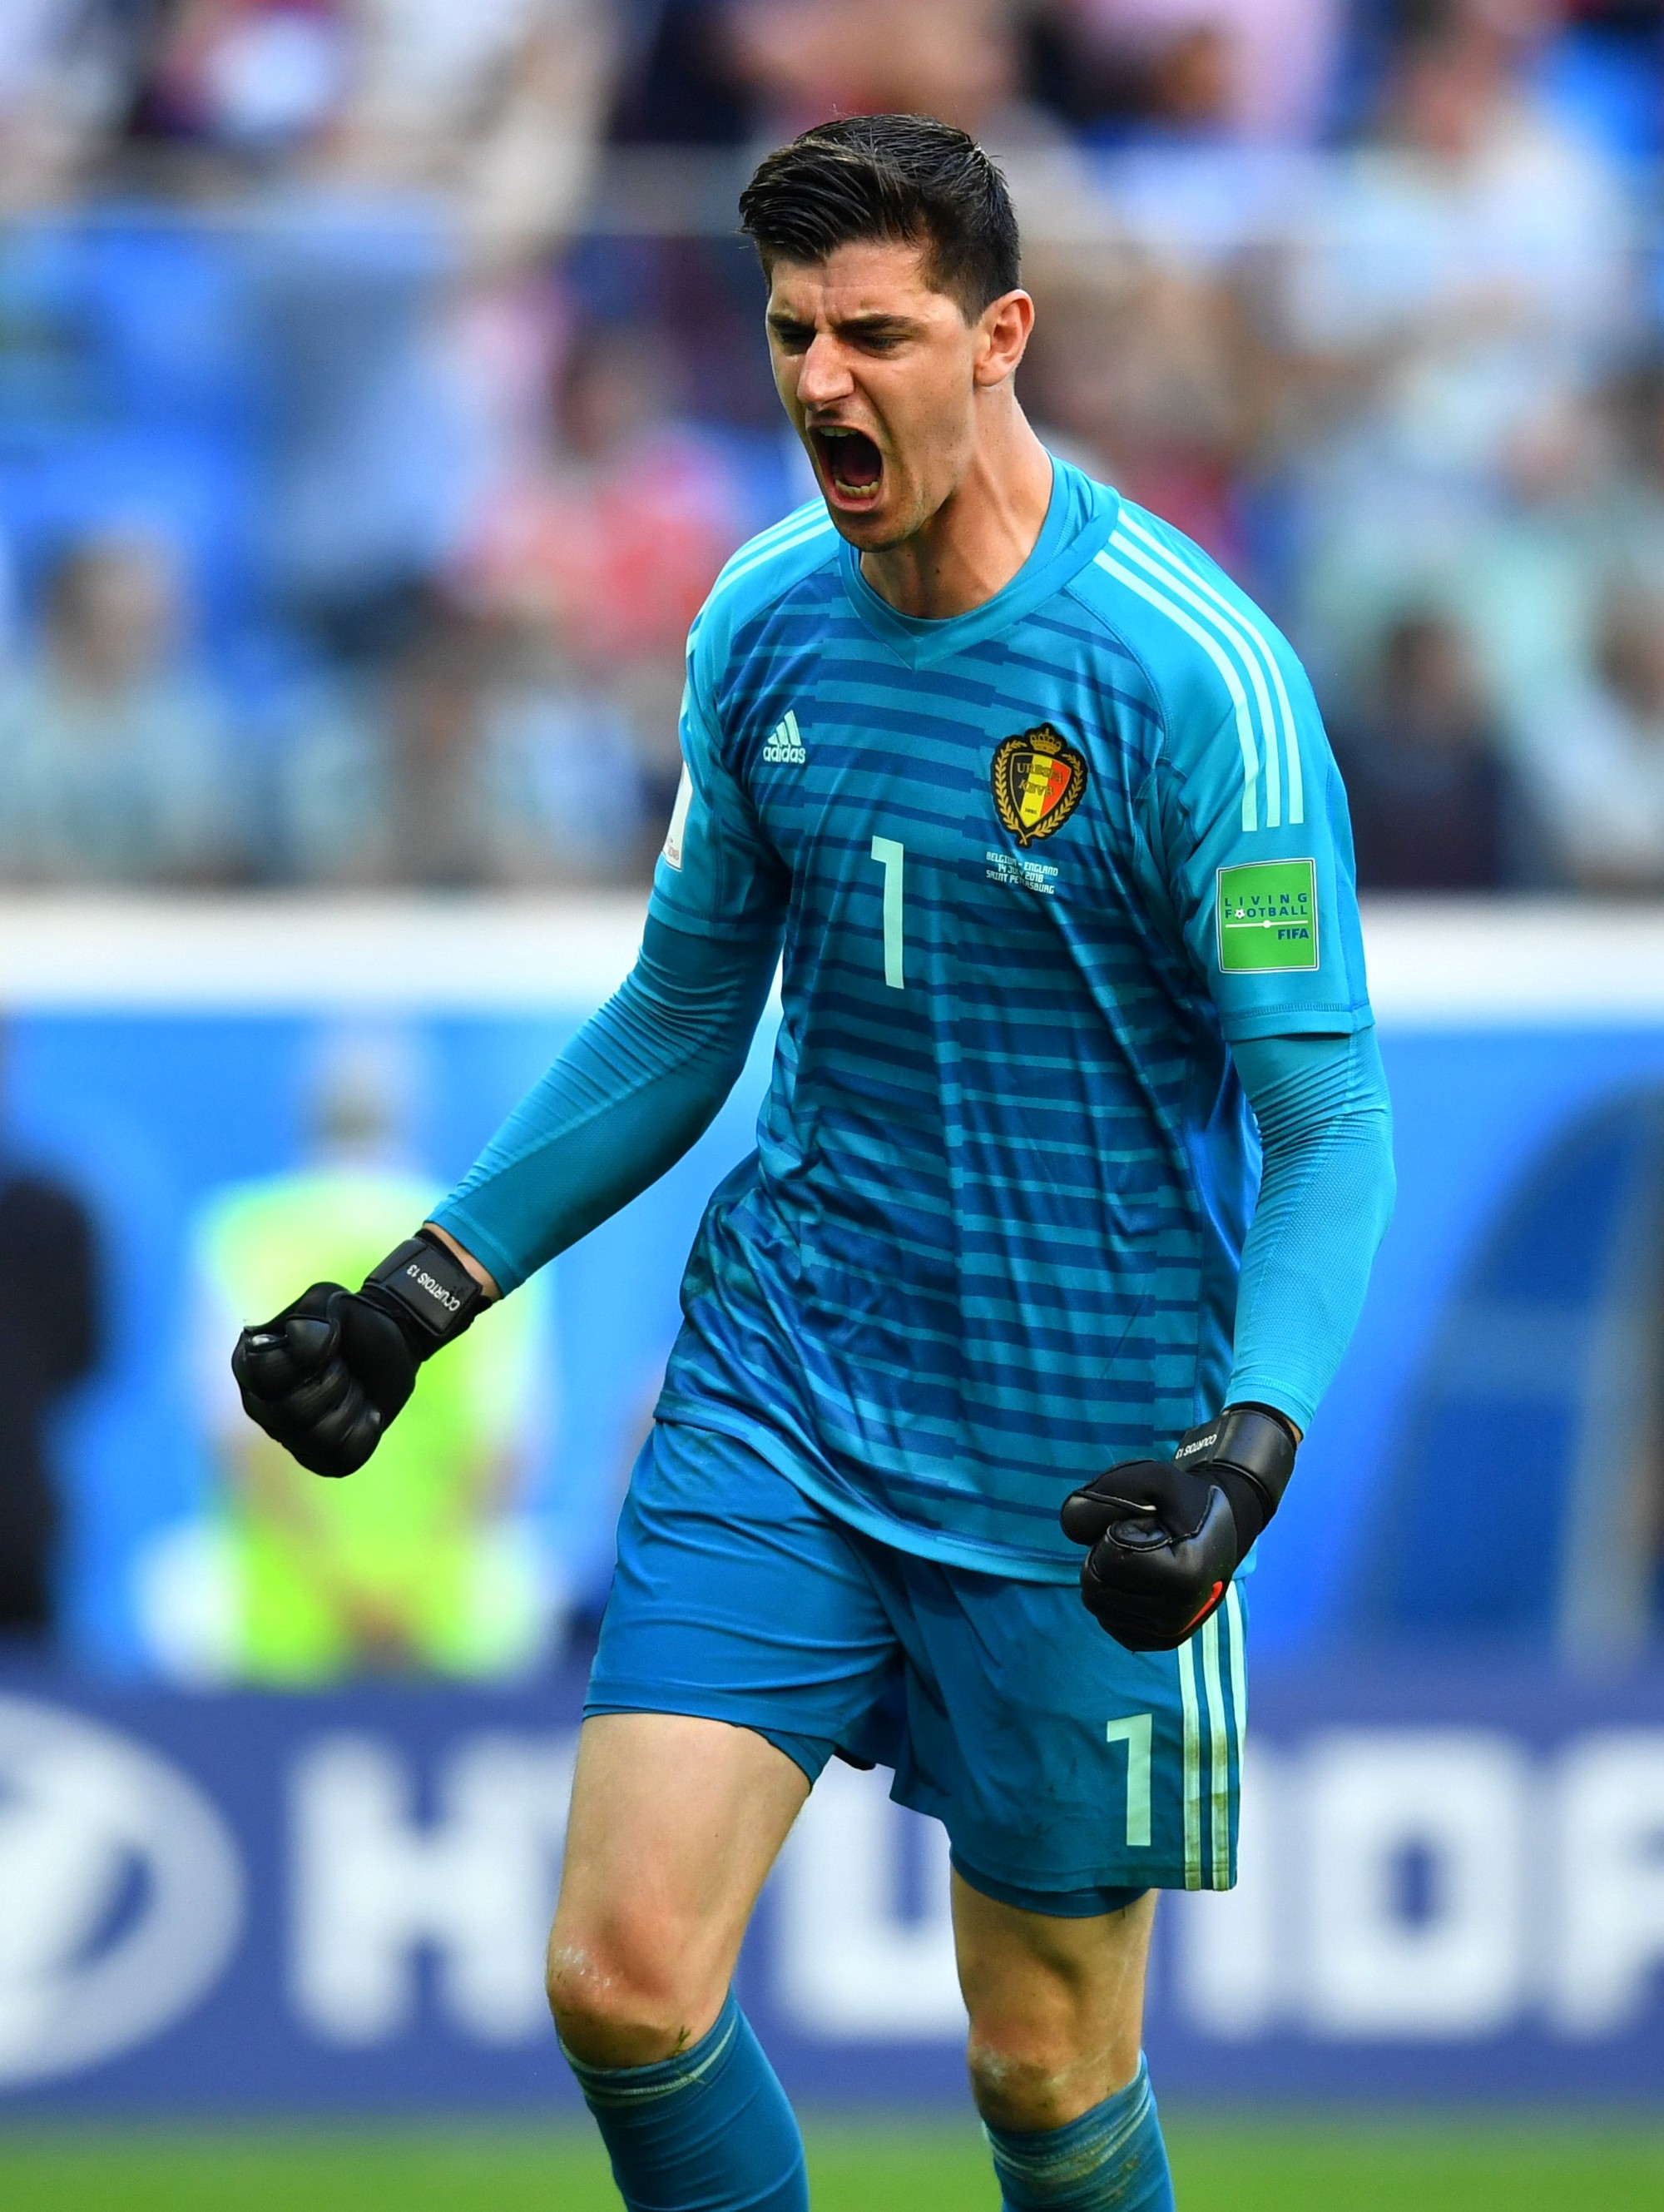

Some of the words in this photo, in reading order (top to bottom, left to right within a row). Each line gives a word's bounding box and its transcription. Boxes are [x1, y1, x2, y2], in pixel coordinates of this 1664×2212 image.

[763, 744, 805, 764] adidas
[986, 851, 1017, 865] BELGIUM
[1023, 861, 1059, 877] ENGLAND
[986, 870, 1008, 882] SAINT
[998, 863, 1007, 873] 14
[1024, 871, 1044, 883] 2018
[1224, 893, 1308, 907] LIVING
[871, 835, 904, 989] 1
[1225, 905, 1308, 920] FOOTBALL
[1277, 928, 1310, 940] FIFA
[406, 1264, 420, 1277] 13
[1107, 1713, 1152, 1847] 1
